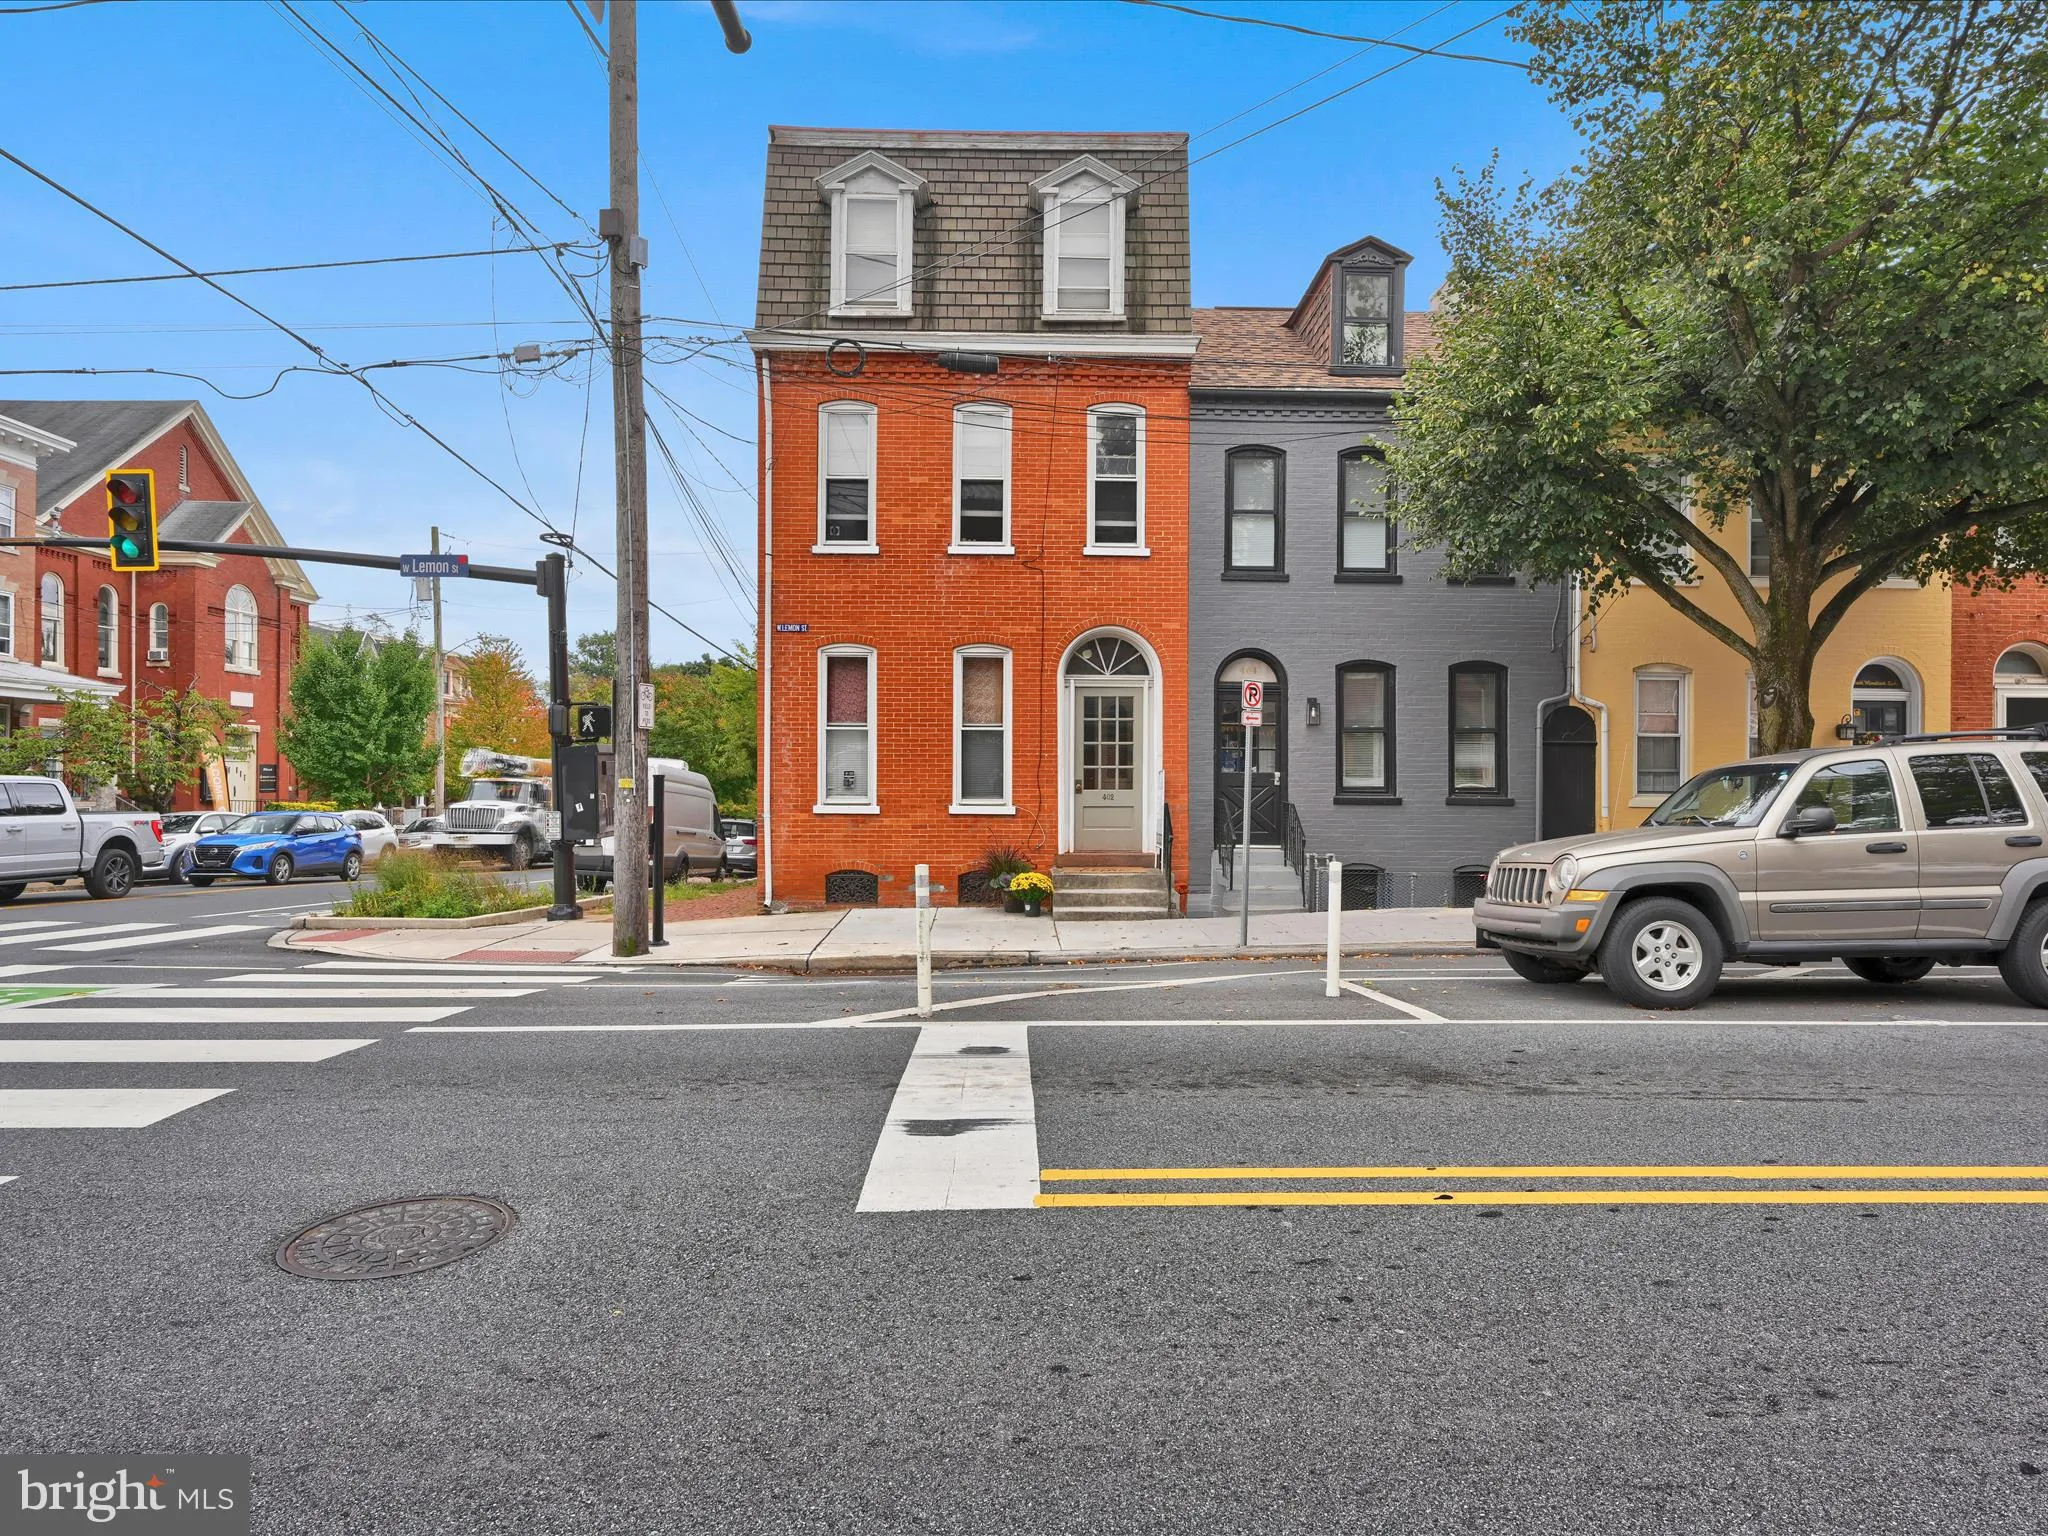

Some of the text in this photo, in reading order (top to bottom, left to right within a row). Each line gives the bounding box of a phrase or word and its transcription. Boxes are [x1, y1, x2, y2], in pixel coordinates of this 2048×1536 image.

[402, 559, 459, 574] W Lemon St
